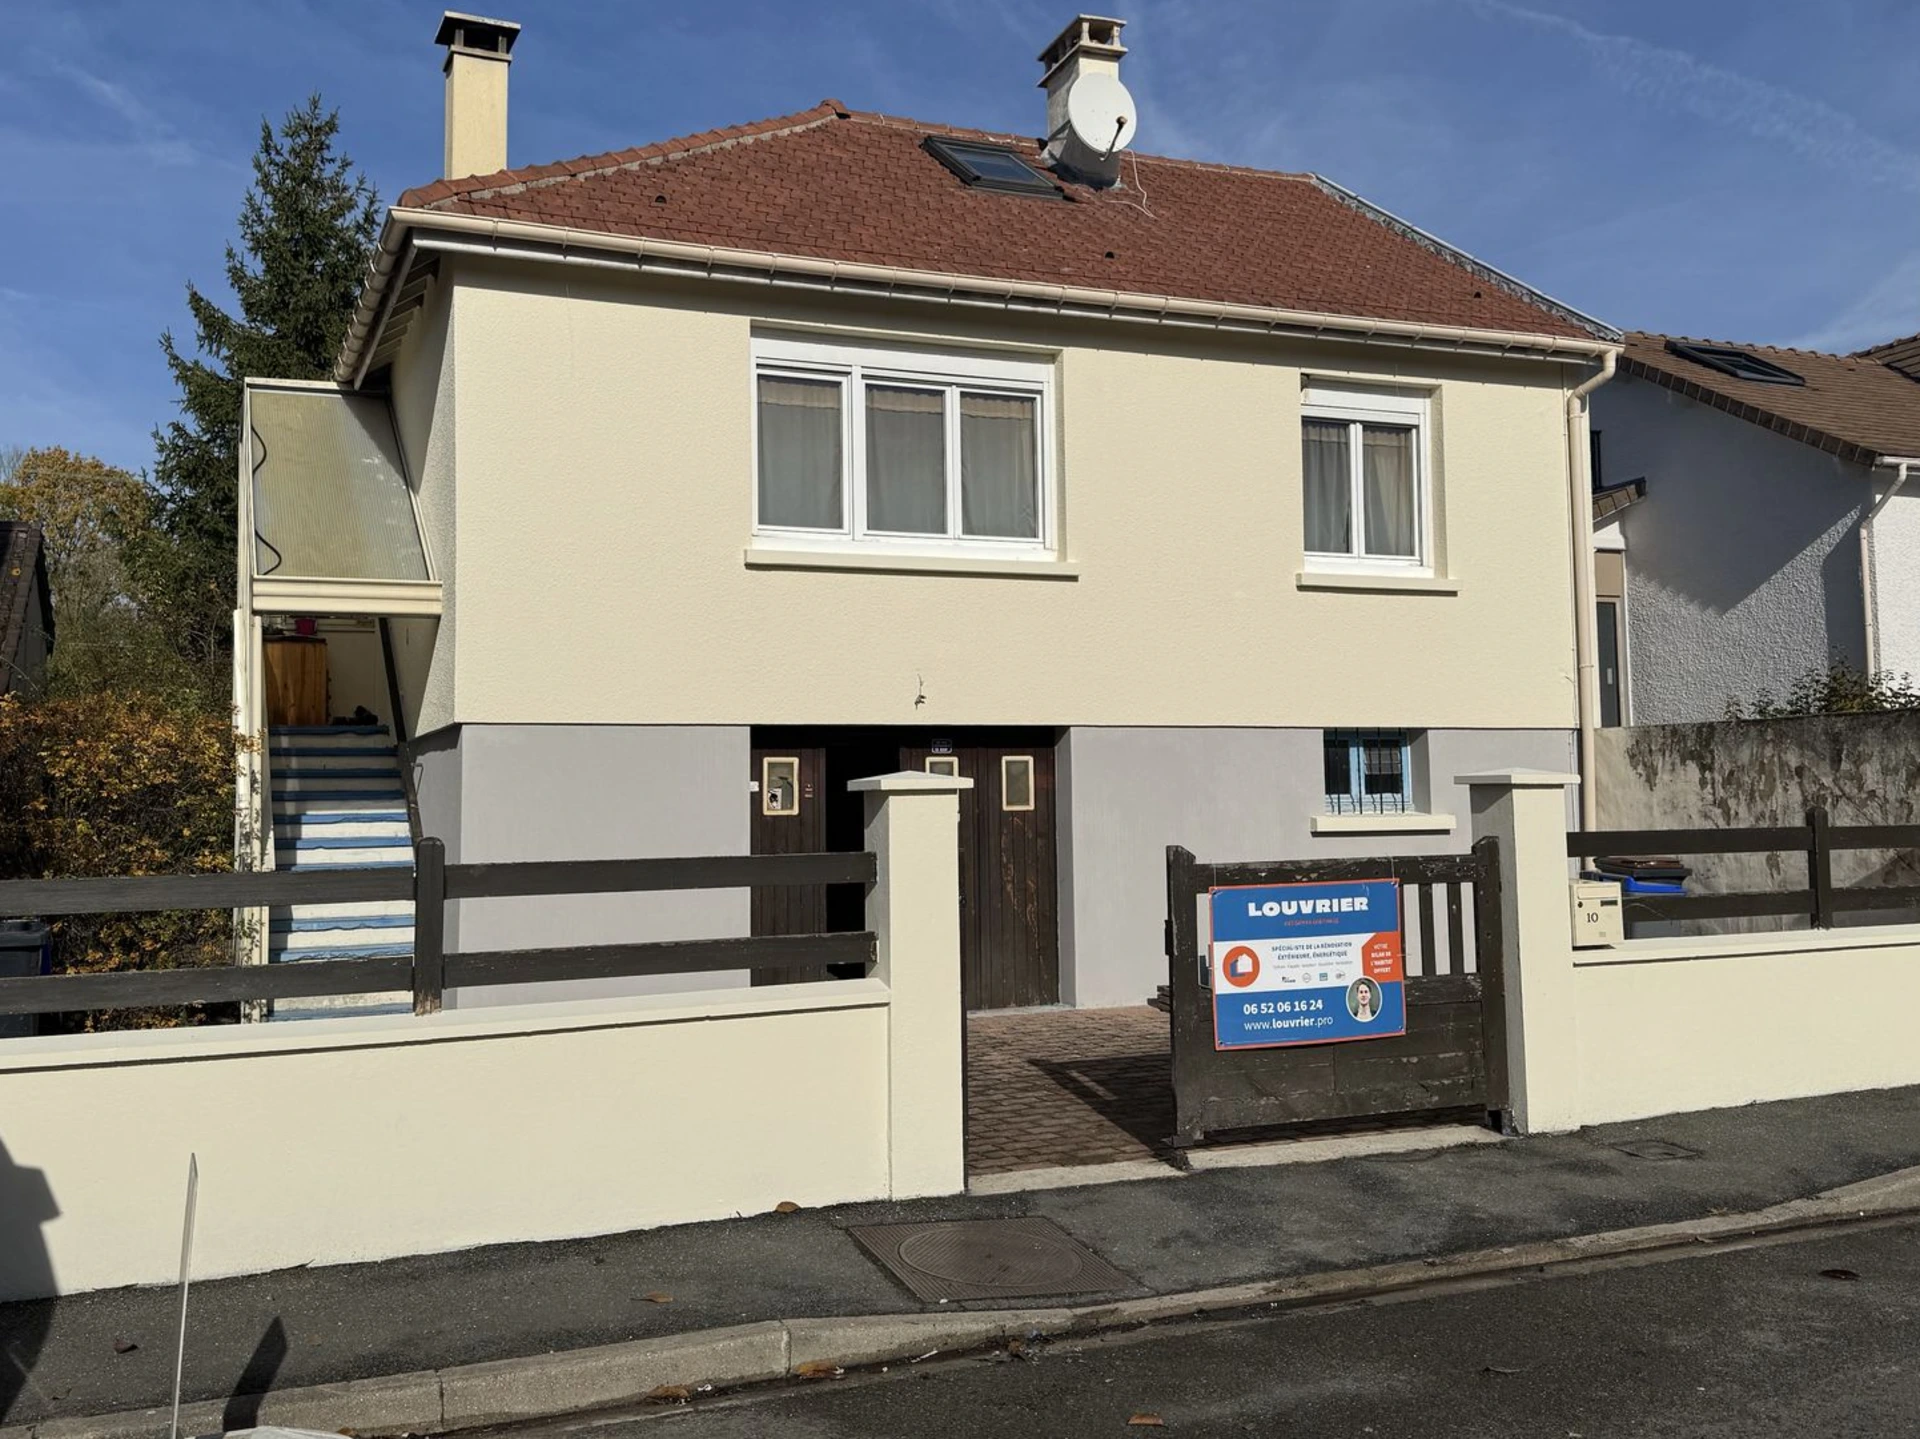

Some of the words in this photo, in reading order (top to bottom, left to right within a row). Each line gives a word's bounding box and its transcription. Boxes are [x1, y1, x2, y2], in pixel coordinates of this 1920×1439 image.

[1248, 897, 1369, 917] LOUVRIER
[1587, 912, 1599, 923] 10
[1243, 1003, 1258, 1015] 06
[1260, 1002, 1275, 1014] 52
[1277, 1001, 1291, 1013] 06
[1293, 1000, 1308, 1012] 16
[1309, 999, 1323, 1011] 24
[1243, 1016, 1334, 1031] www.louvrier.pro
